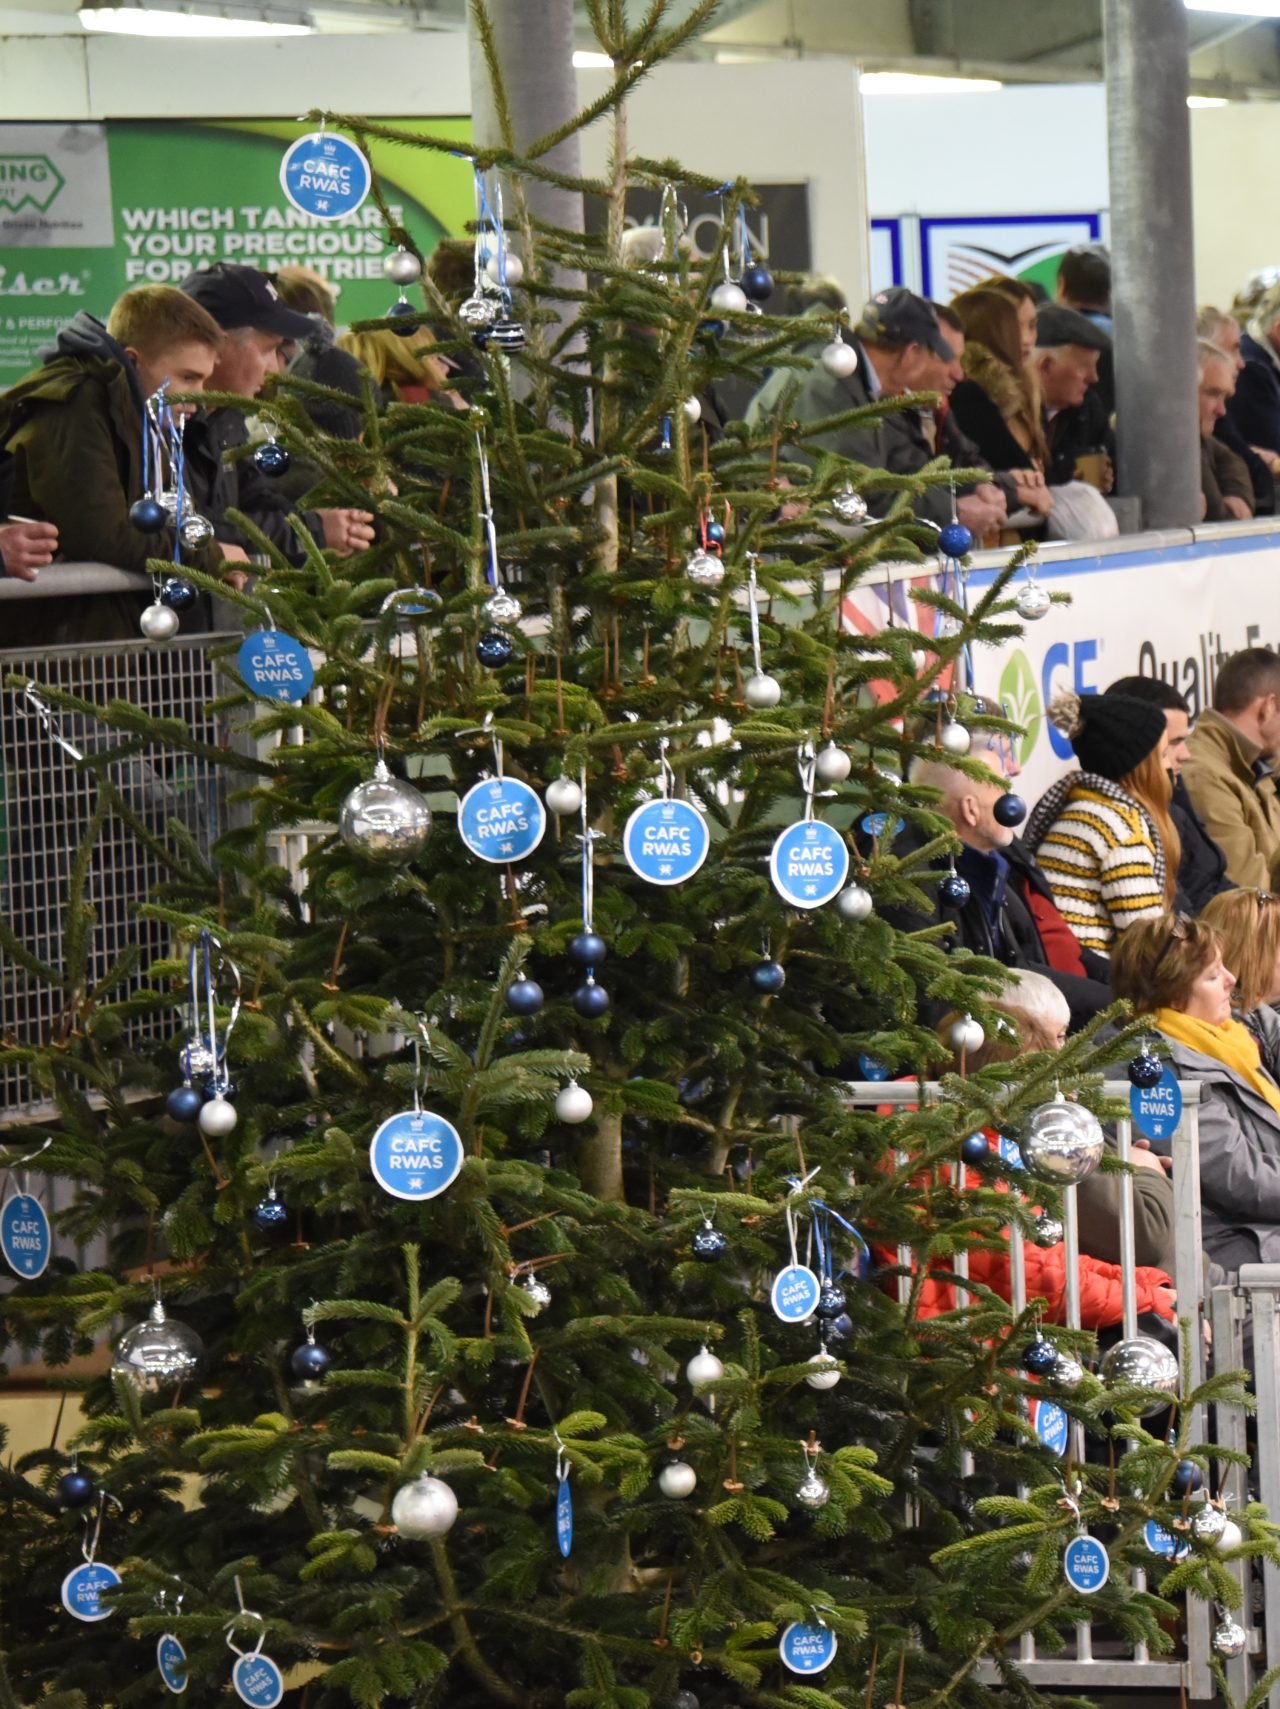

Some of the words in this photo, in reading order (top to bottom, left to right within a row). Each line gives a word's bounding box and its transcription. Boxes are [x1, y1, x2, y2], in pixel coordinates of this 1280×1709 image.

[303, 160, 350, 180] CAFC
[300, 174, 351, 195] RWAS
[122, 207, 235, 230] WHICH
[123, 233, 217, 256] YOUR
[224, 232, 385, 252] PRECIOUS
[251, 653, 297, 668] CAFC
[254, 668, 303, 682] RWAS
[475, 802, 524, 822] CAFC
[478, 817, 529, 839] RWAS
[644, 826, 691, 841] CAFC
[642, 842, 692, 856] RWAS
[789, 847, 832, 861] CAFC
[788, 862, 834, 876] RWAS
[1140, 1088, 1174, 1101] CAFC
[1140, 1101, 1175, 1117] RWAS
[391, 1139, 442, 1153] CAFC
[389, 1155, 443, 1169] RWAS
[11, 1220, 39, 1235] CAFC
[12, 1236, 41, 1251] RWAS
[781, 1280, 808, 1297] CAFC
[782, 1290, 811, 1307] RWAS
[1074, 1555, 1098, 1564] CAFC
[1073, 1565, 1100, 1575] RWAS
[77, 1580, 109, 1591] CAFC
[77, 1591, 101, 1602] RW
[793, 1635, 823, 1646] CAFC
[792, 1644, 825, 1656] RWAS
[244, 1667, 268, 1687] CAFC
[248, 1675, 273, 1696] RWAS
